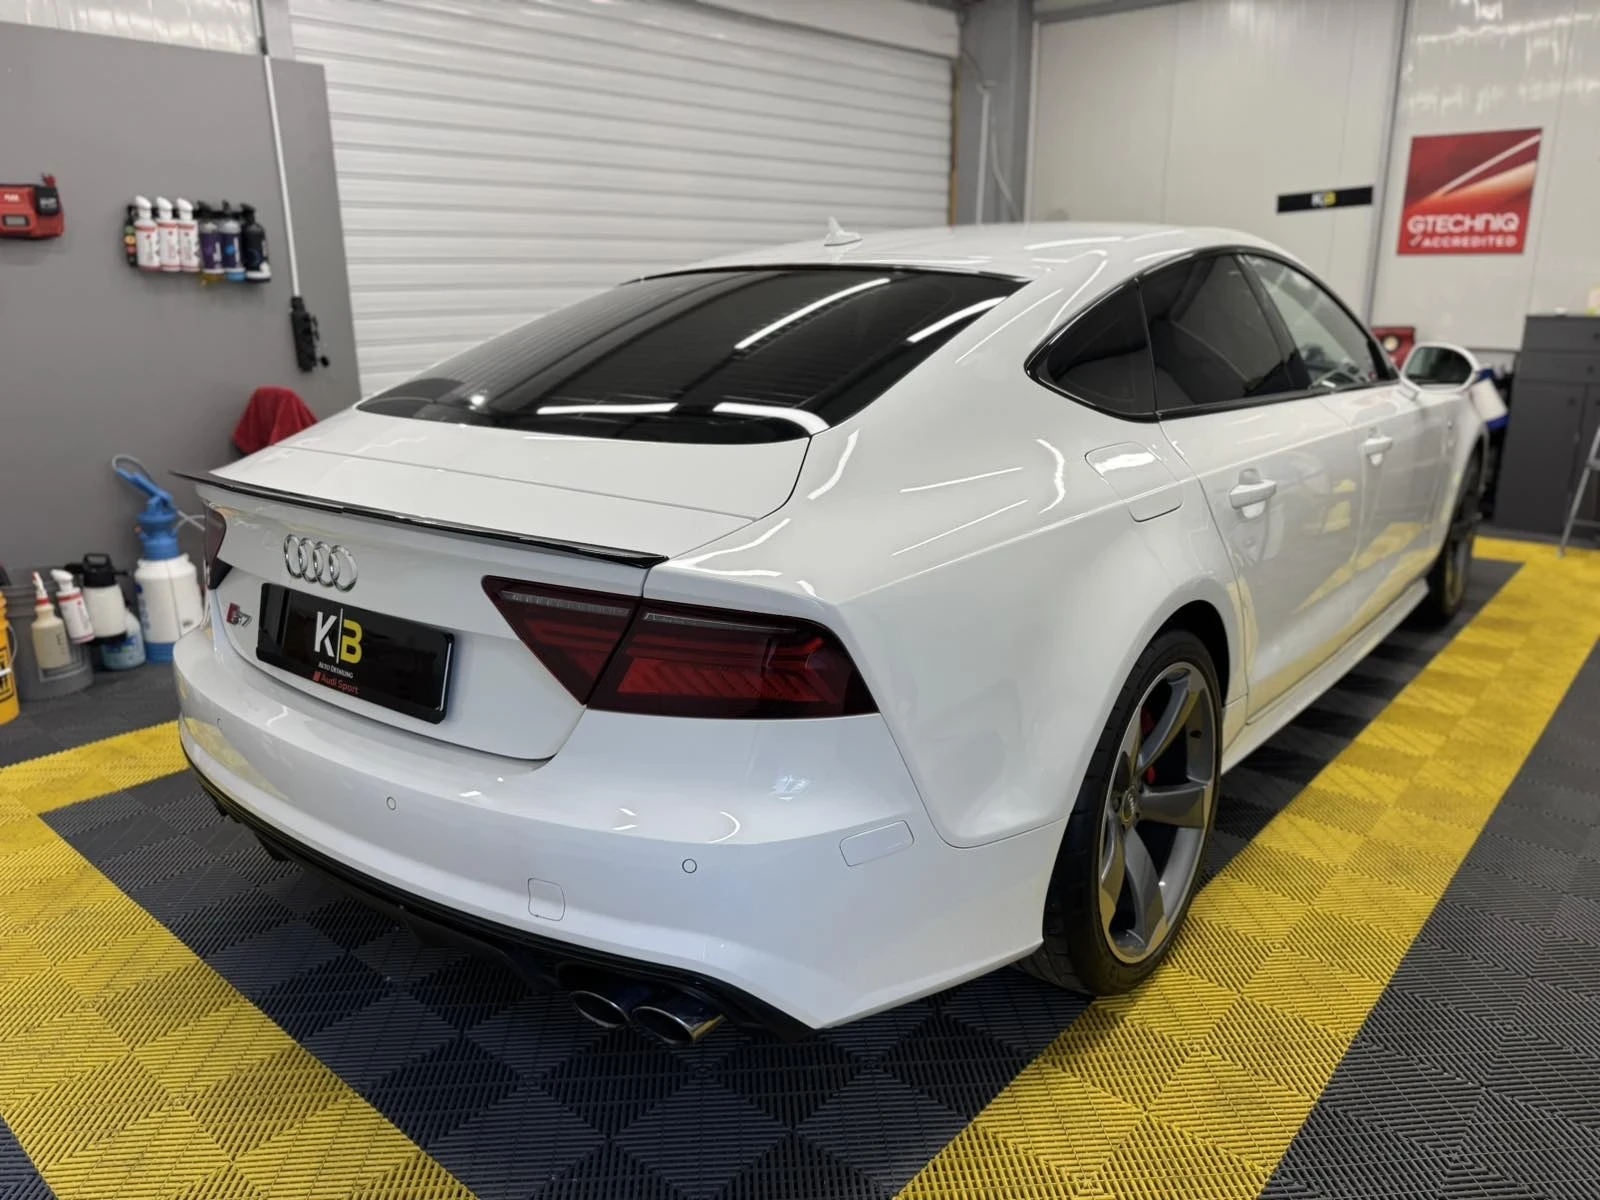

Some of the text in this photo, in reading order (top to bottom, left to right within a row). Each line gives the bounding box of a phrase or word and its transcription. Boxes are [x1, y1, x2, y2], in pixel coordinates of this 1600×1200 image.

[1407, 212, 1520, 234] GTECHNIQ
[1421, 235, 1518, 248] ACCREDITED
[321, 674, 359, 694] Audi Sport
